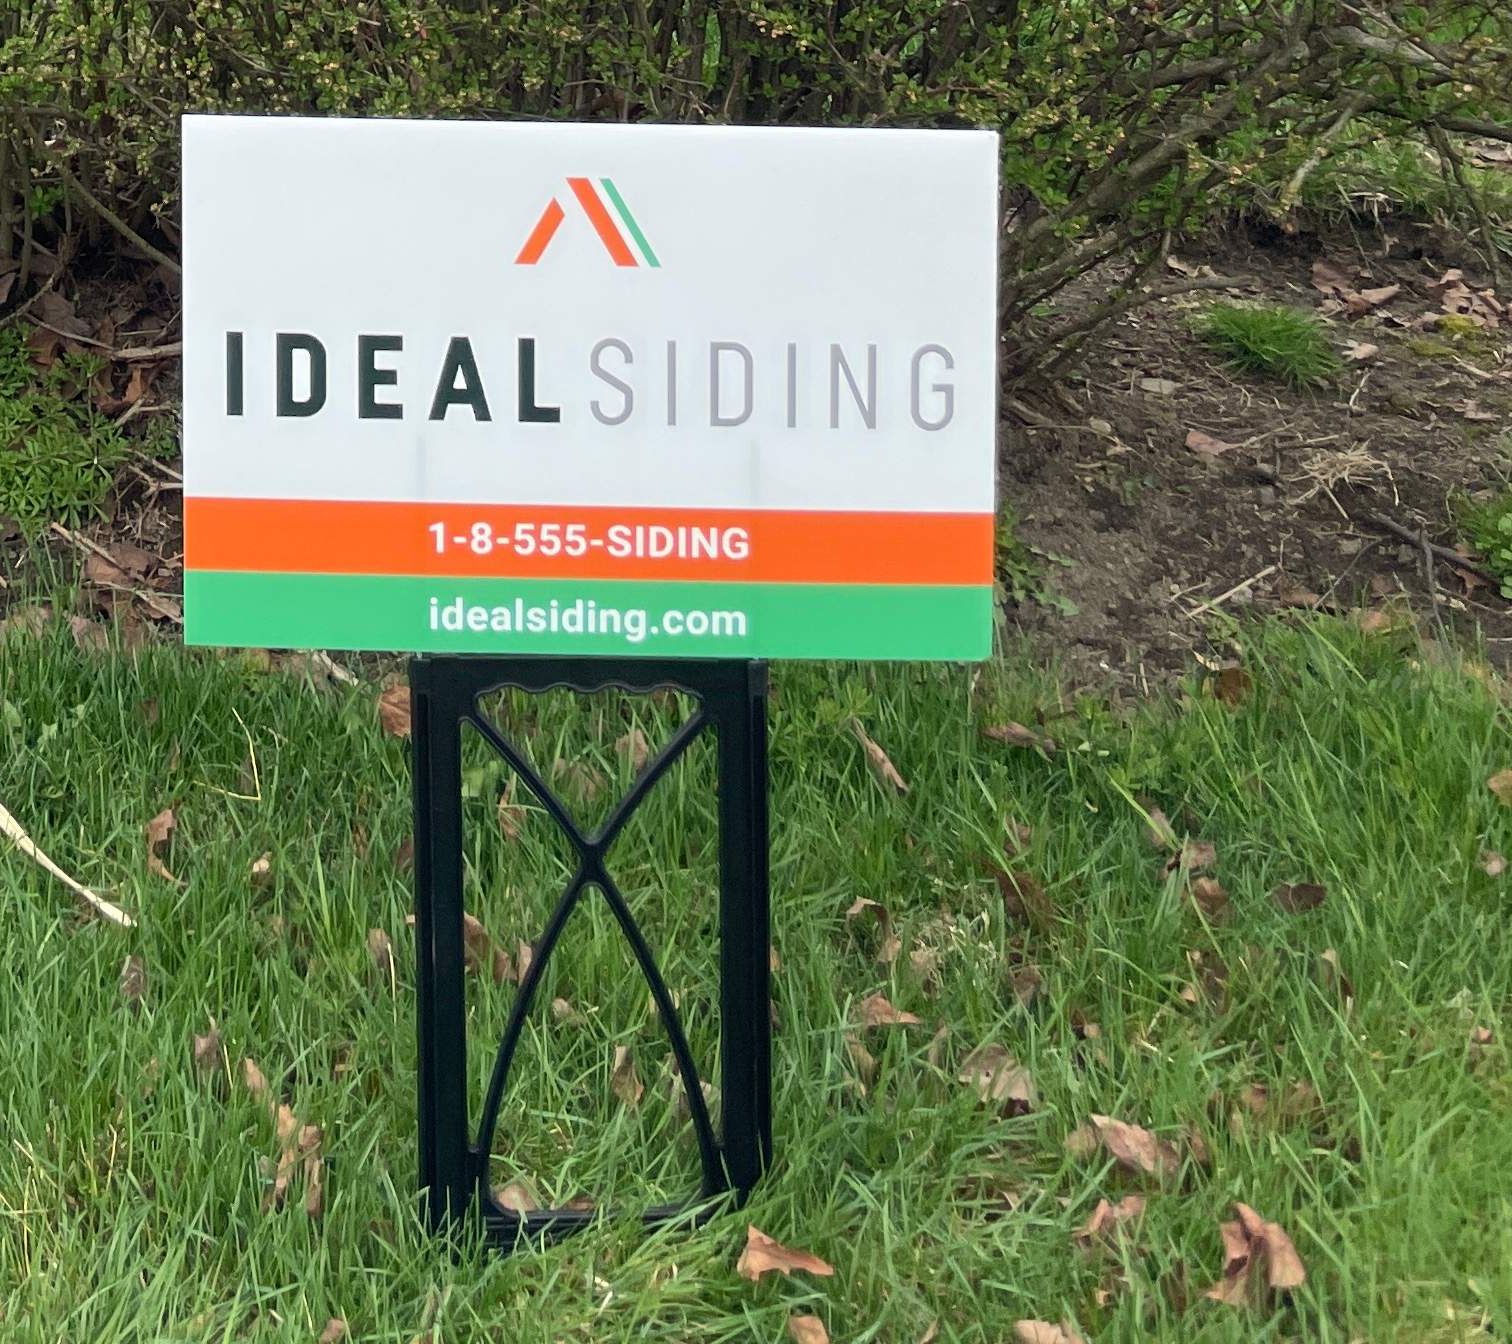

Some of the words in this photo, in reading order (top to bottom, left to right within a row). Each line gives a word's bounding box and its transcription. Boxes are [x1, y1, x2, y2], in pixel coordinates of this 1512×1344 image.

[225, 330, 956, 431] IDEALSIDING
[428, 521, 750, 560] 1-8-555-SIDING
[428, 596, 747, 642] idealsiding.com
